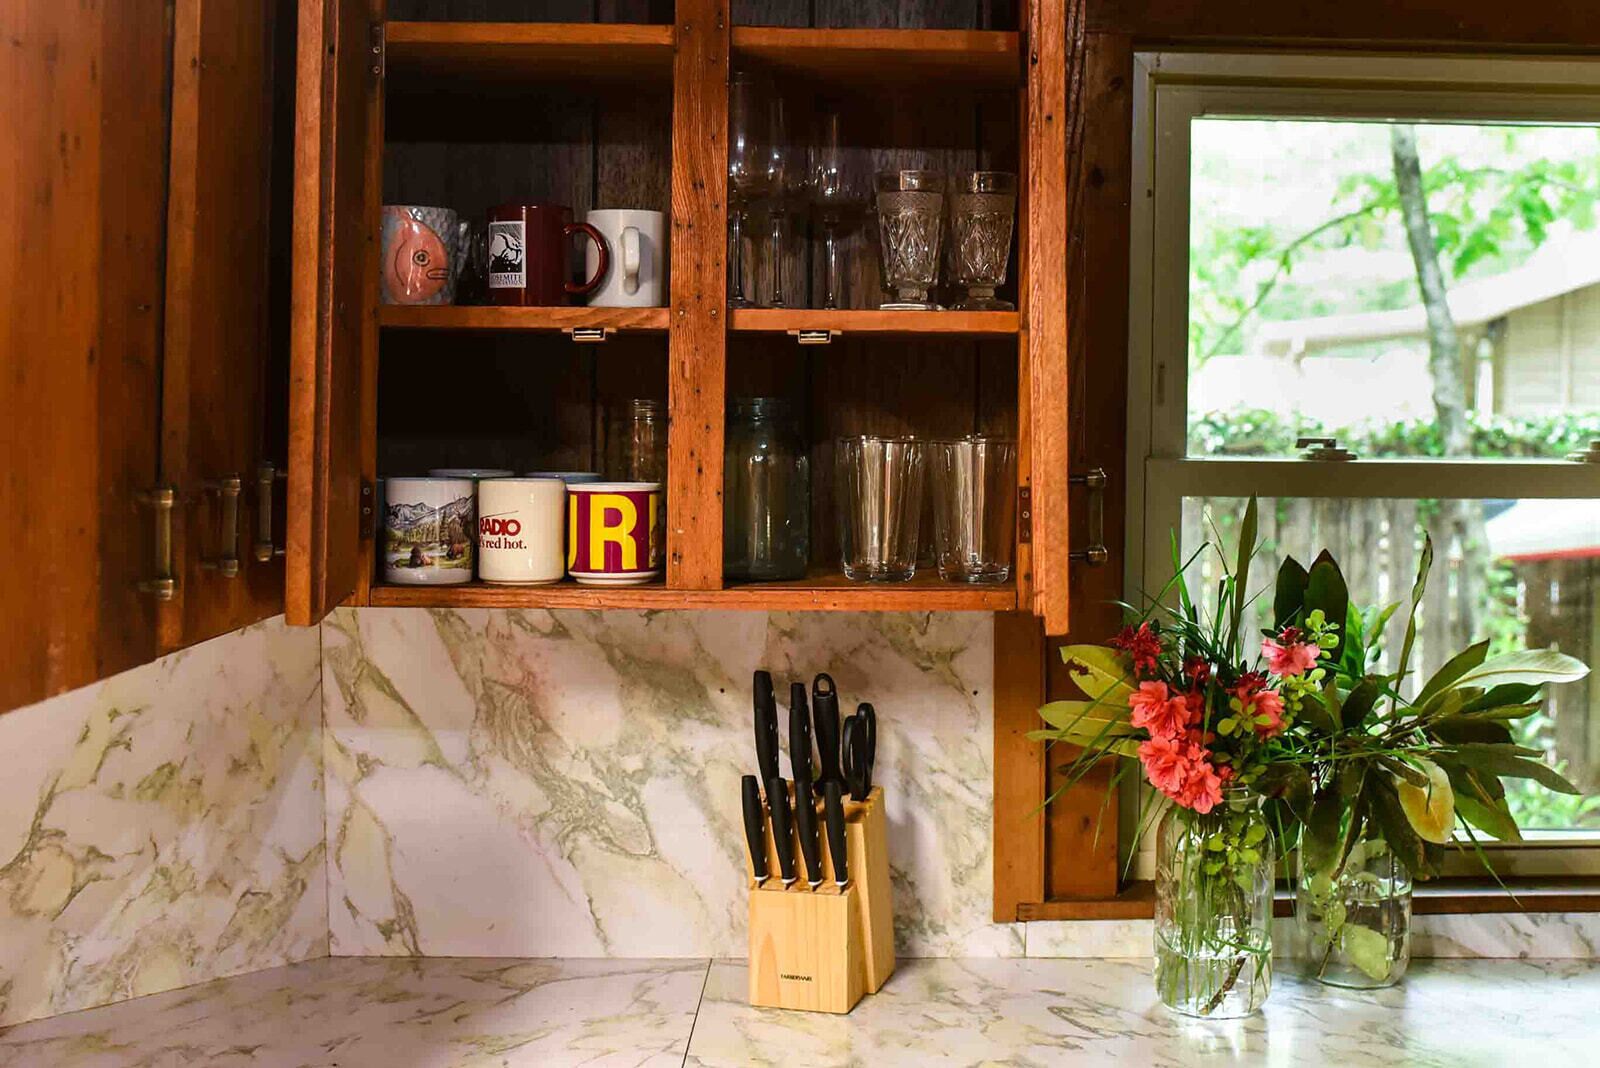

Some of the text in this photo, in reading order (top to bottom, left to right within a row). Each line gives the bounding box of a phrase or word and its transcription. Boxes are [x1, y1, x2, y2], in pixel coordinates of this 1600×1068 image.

[480, 518, 521, 536] RADIO
[486, 537, 501, 549] red
[504, 537, 527, 549] hot.
